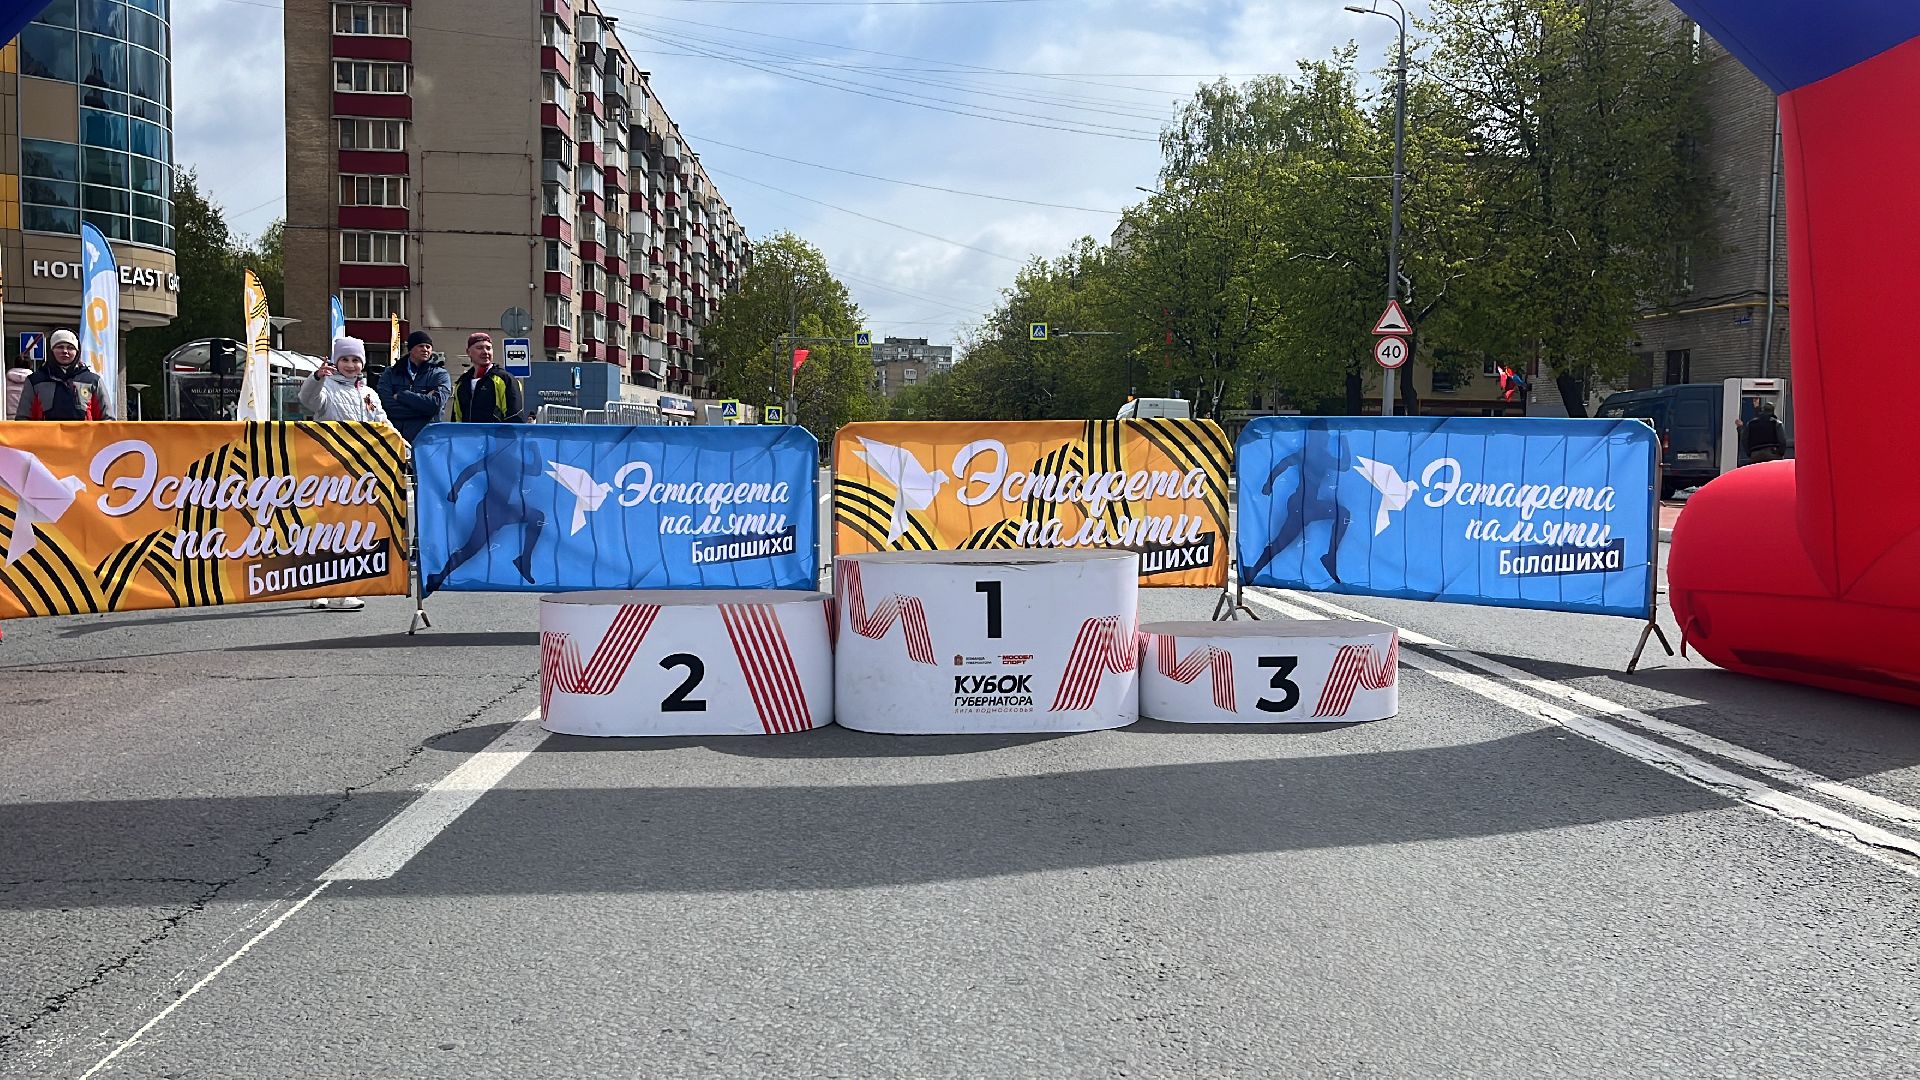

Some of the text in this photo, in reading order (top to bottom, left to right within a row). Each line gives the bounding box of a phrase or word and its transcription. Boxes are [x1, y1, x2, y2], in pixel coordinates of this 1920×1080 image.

[33, 259, 83, 280] HOT
[120, 265, 163, 288] EAST
[1381, 345, 1401, 359] 40
[89, 439, 381, 526] Эстафета
[614, 461, 790, 515] Эстафета
[951, 438, 1207, 518] Эстафета
[1421, 457, 1616, 520] Эстафета
[171, 519, 380, 561] памяти
[660, 512, 787, 536] памяти
[1016, 513, 1205, 548] памяти
[1464, 518, 1613, 549] памяти
[691, 535, 793, 565] Балашиха
[1499, 549, 1620, 576] Балашиха
[249, 550, 387, 596] Балашиха
[976, 581, 1002, 638] 1
[659, 653, 706, 712] 2
[954, 674, 1033, 694] КУБОК
[954, 696, 1034, 707] ГУБЕРНАТОРА
[1256, 656, 1300, 712] 3
